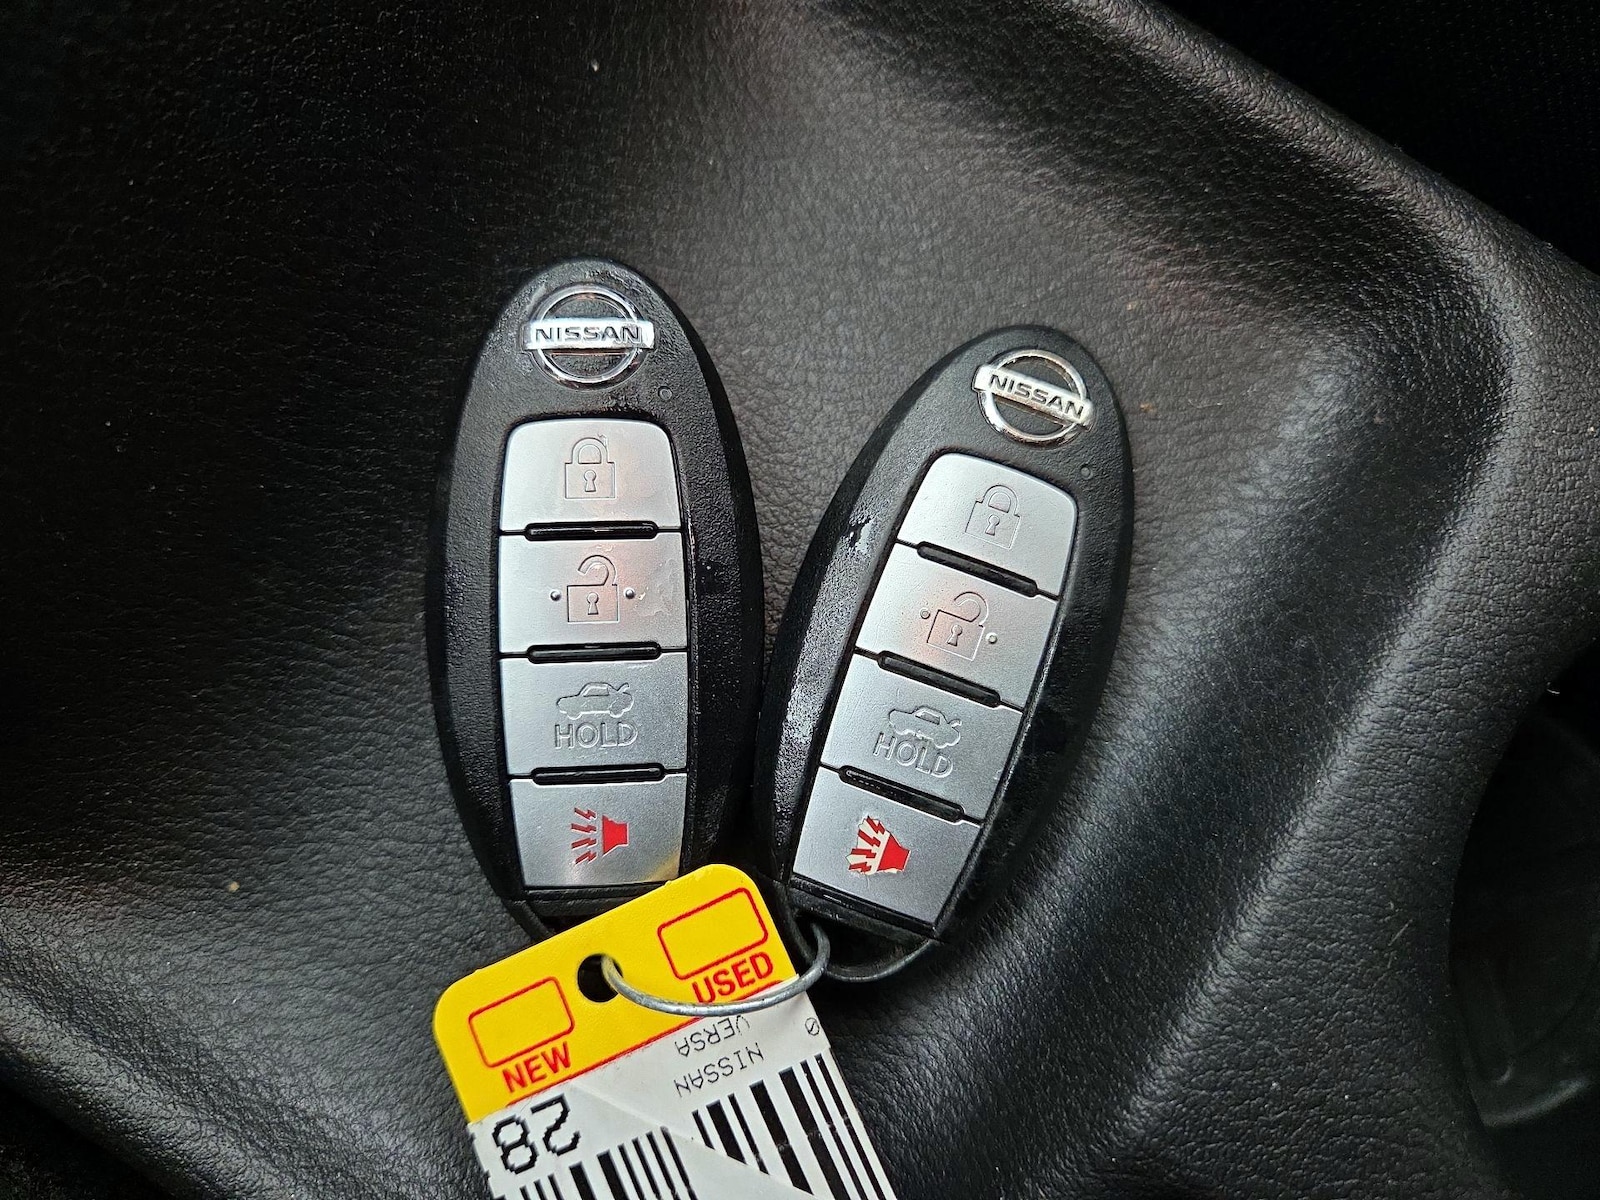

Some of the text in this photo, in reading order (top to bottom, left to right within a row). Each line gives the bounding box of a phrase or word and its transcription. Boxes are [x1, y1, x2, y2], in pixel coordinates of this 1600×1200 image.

[535, 326, 640, 342] NISSAN
[989, 374, 1084, 420] NISSAN
[554, 721, 638, 750] HOLD
[873, 732, 954, 778] HOLD
[692, 952, 774, 1005] USED
[675, 1013, 751, 1057] VERSA
[501, 1042, 572, 1093] NEW
[675, 1041, 765, 1098] NISSAN
[492, 1092, 581, 1175] 28
